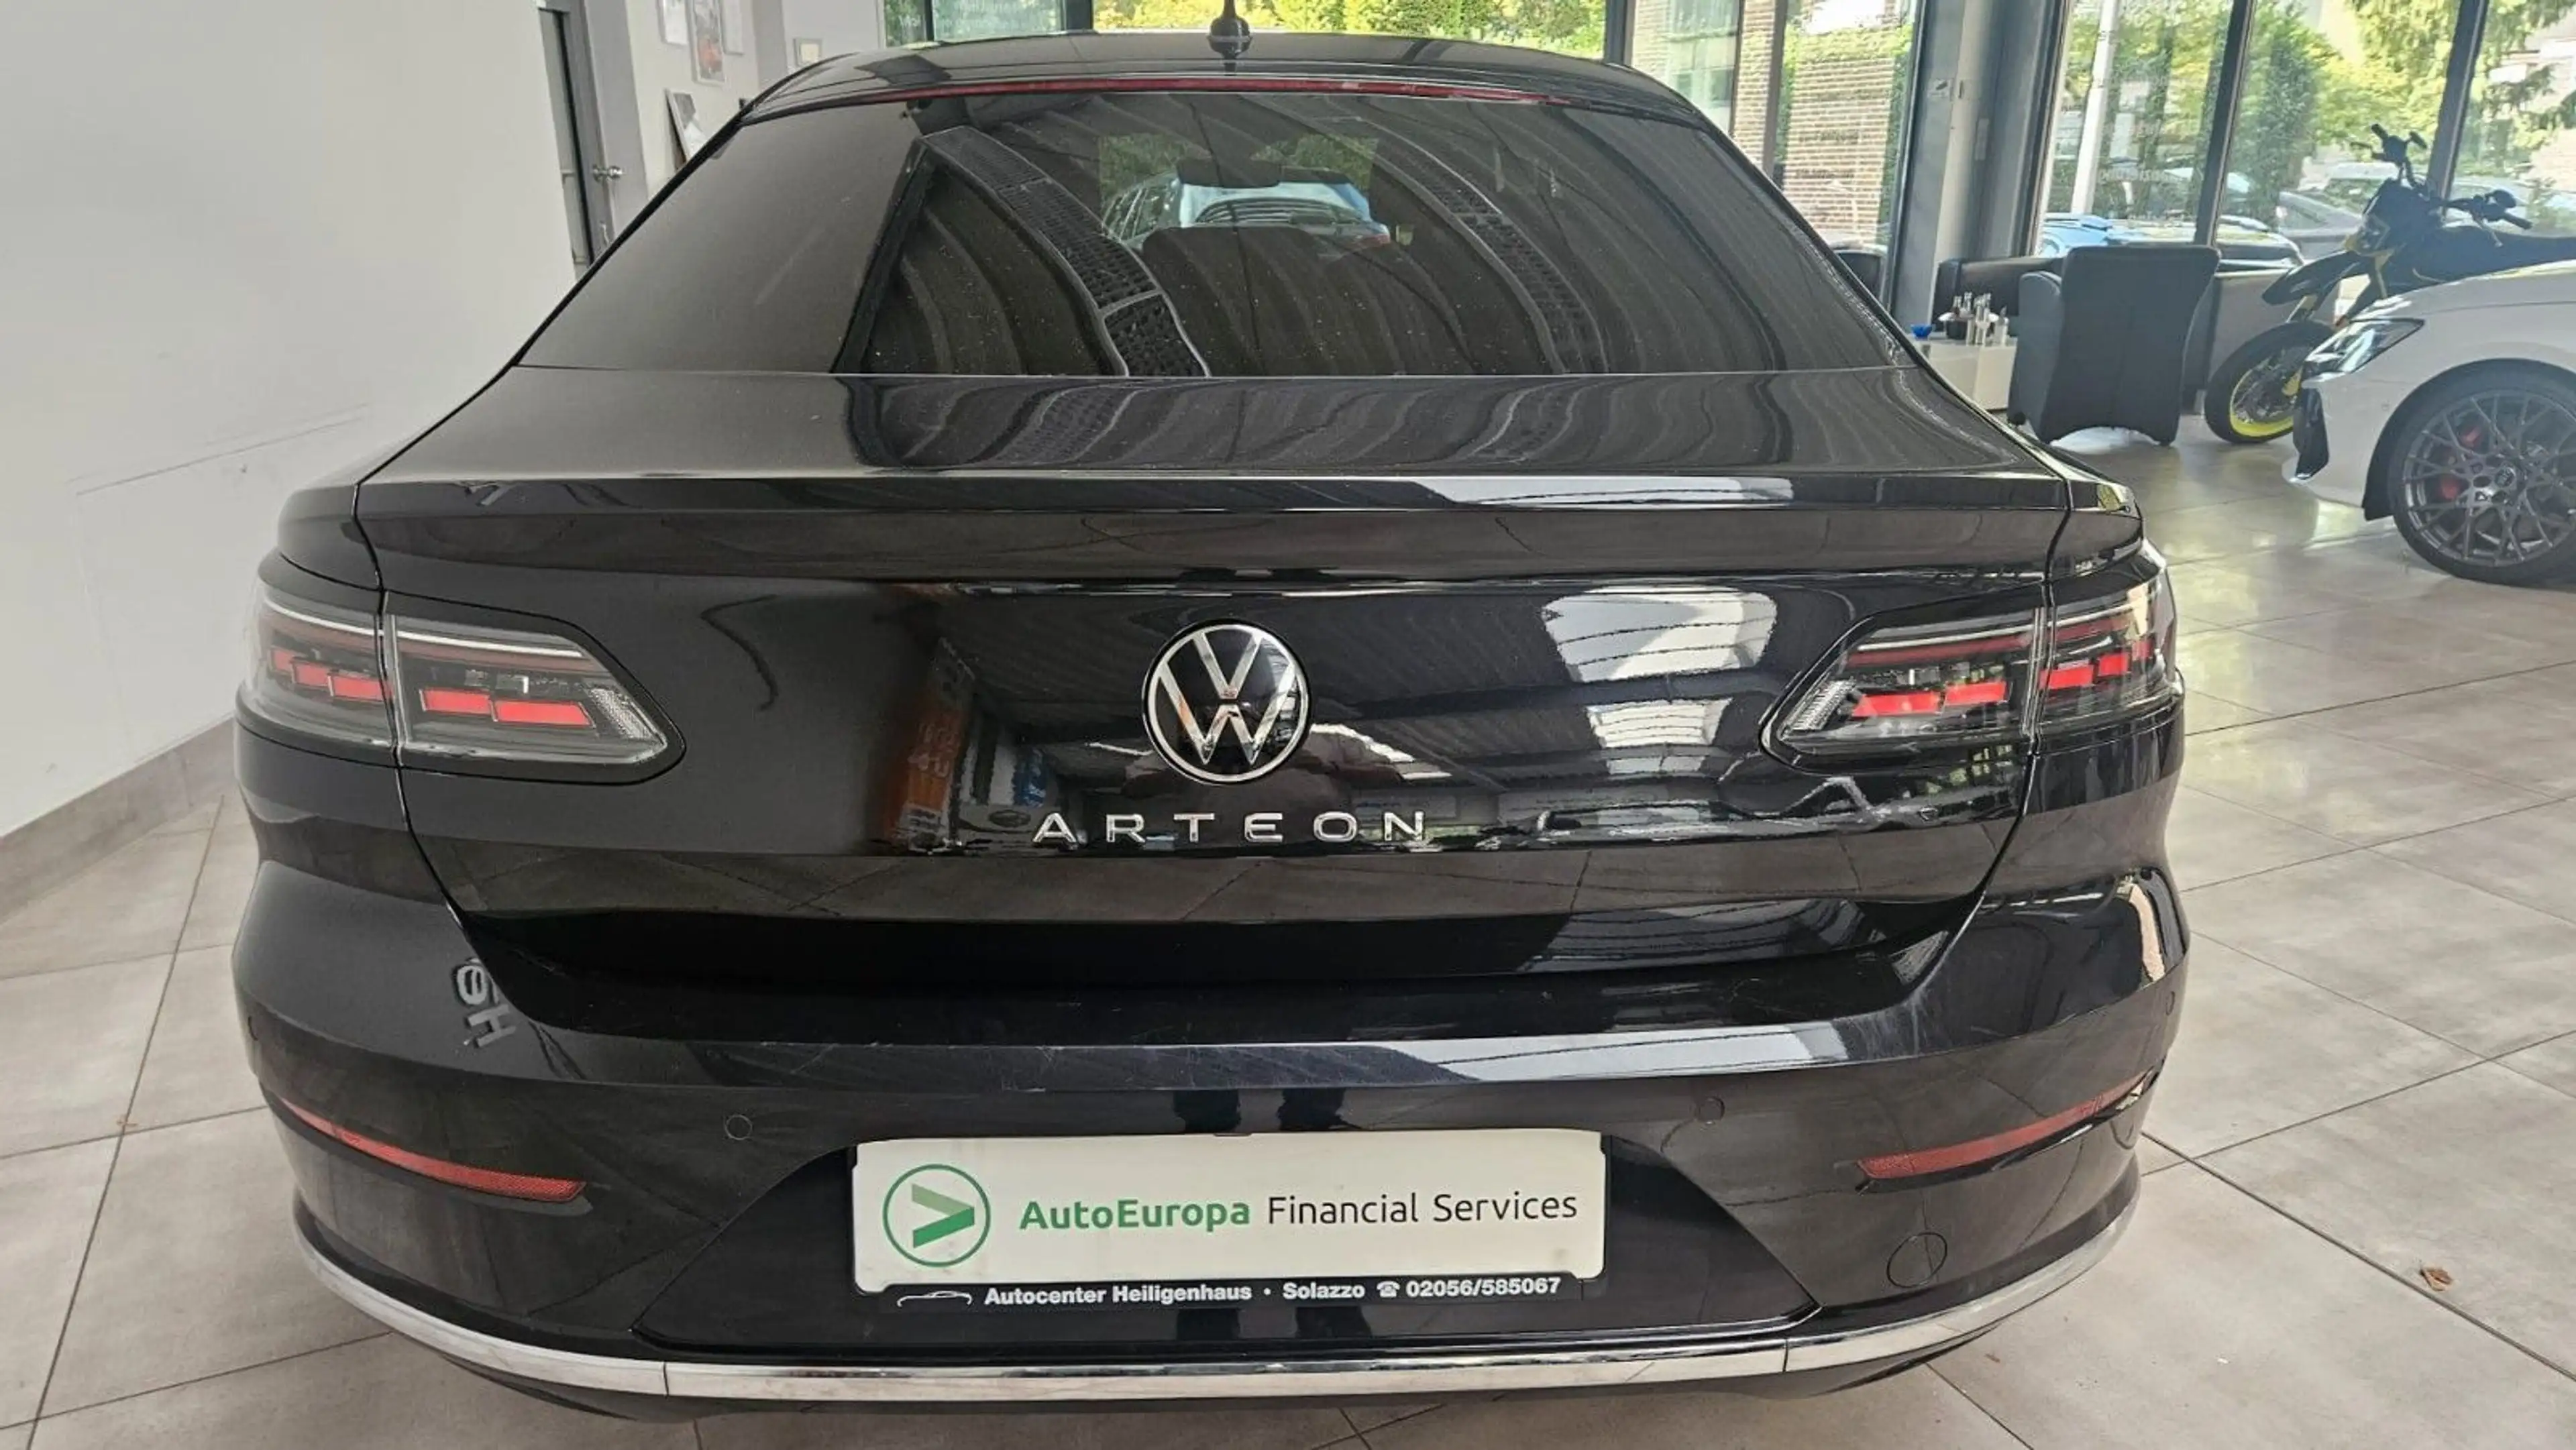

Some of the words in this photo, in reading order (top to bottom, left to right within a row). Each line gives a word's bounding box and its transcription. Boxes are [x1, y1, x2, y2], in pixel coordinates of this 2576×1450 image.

[1032, 812, 1424, 843] ARTEON
[1018, 1198, 1251, 1233] AutoEuropa
[1268, 1192, 1419, 1224] Financial
[1432, 1190, 1578, 1222] Services
[983, 1287, 1107, 1305] Autocenter
[1112, 1284, 1253, 1305] Heiligenhaus
[1283, 1282, 1366, 1300] Solazzo
[1406, 1276, 1562, 1297] 02056/585067
